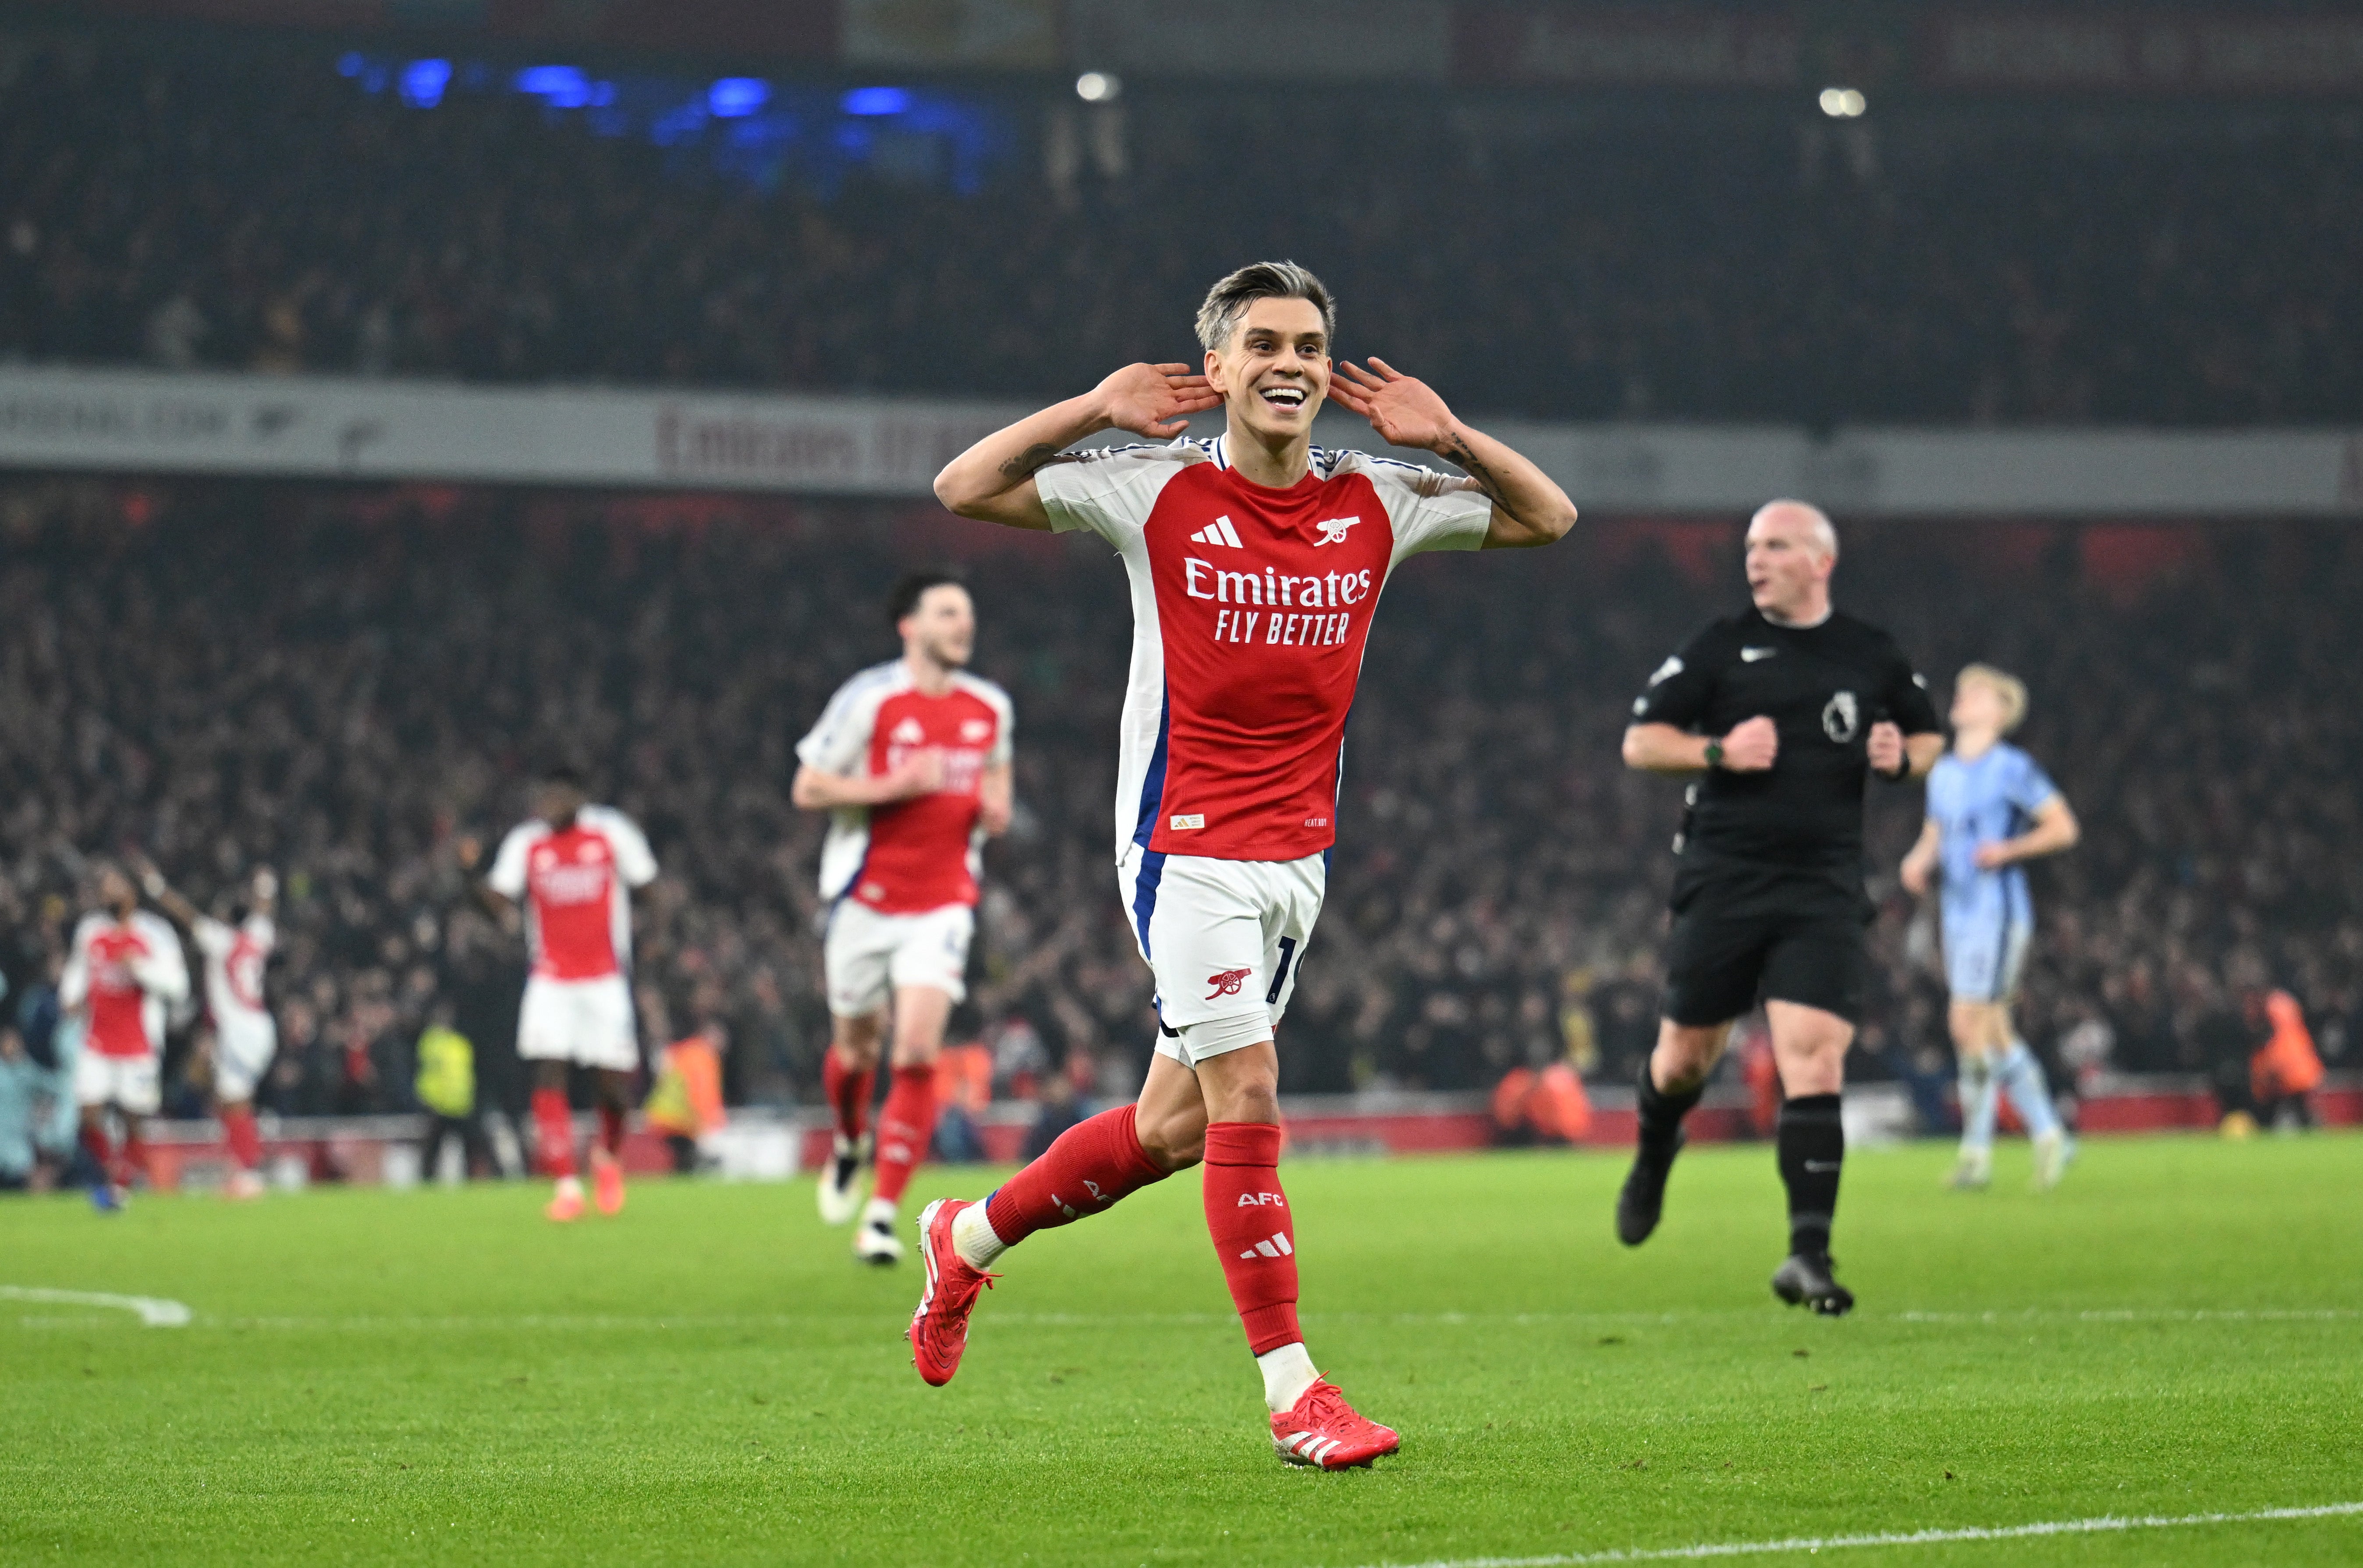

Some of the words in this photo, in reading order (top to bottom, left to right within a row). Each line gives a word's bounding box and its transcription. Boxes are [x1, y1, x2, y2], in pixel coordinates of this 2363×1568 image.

[1184, 557, 1370, 607] Emirates
[1215, 610, 1259, 644] FLY
[1266, 613, 1349, 646] BETTER
[1304, 818, 1327, 827] HEAT.RDY
[1238, 1192, 1284, 1207] AFC
